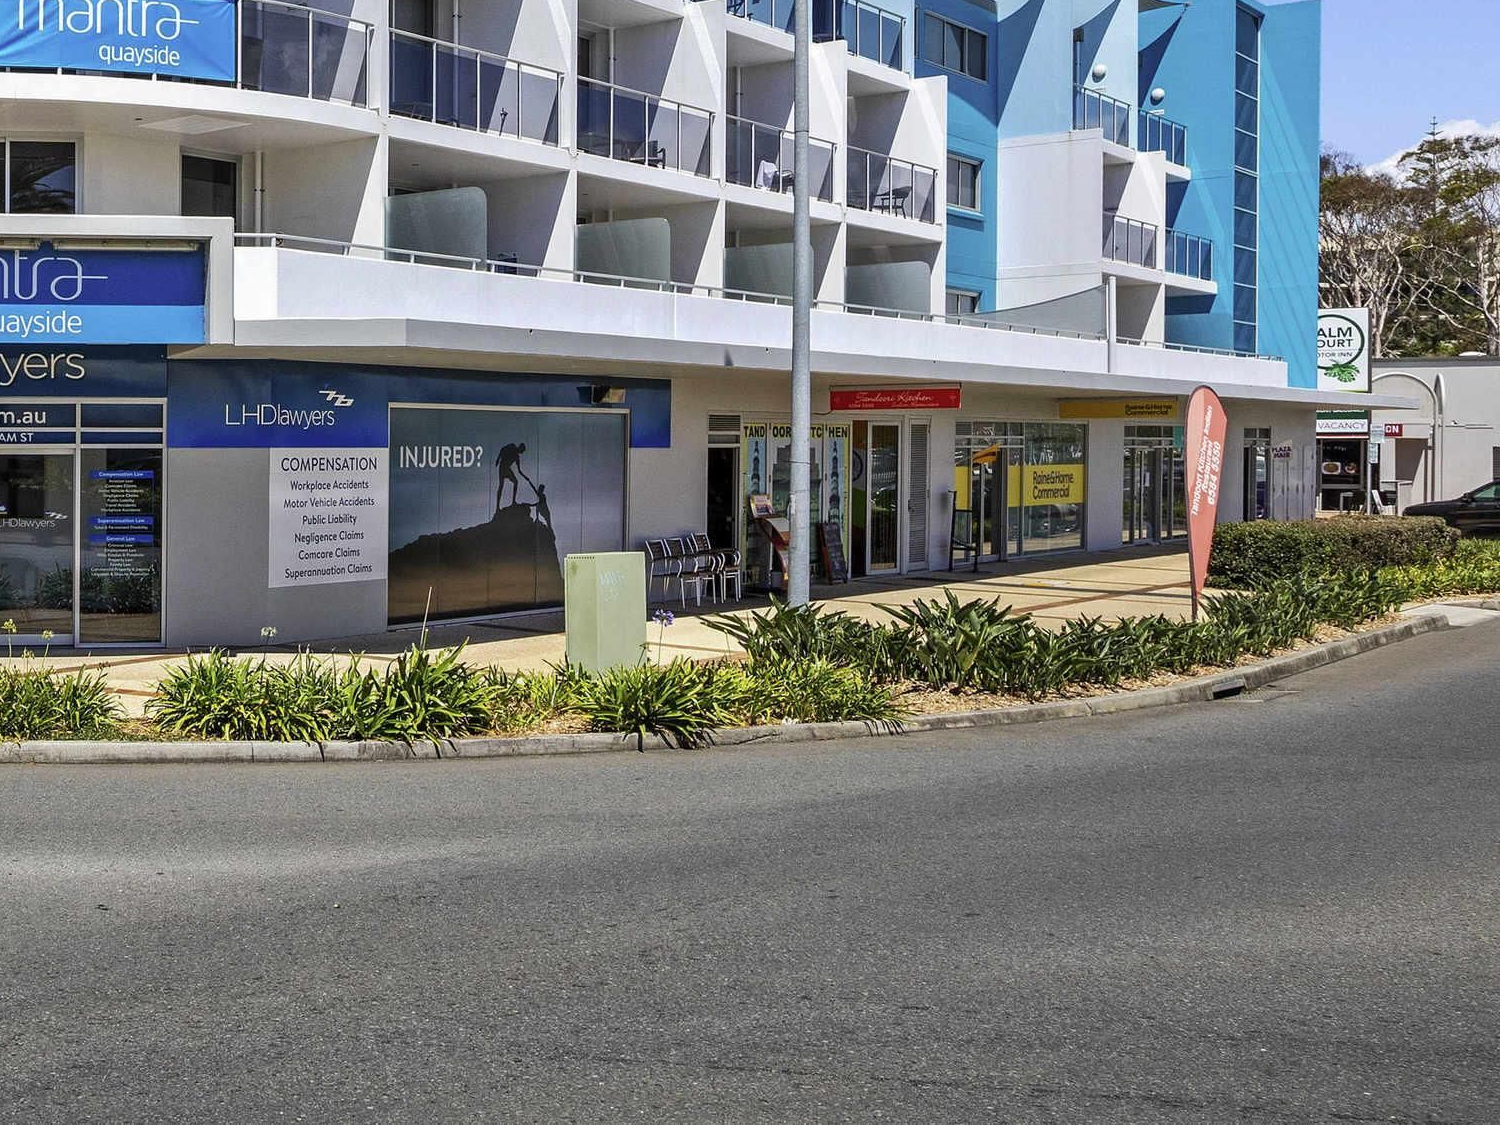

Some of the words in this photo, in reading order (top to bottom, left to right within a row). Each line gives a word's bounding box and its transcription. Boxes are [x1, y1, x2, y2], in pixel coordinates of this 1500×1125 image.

[99, 44, 180, 66] quayside
[1317, 327, 1352, 338] ALM
[1317, 339, 1353, 348] OURT
[225, 404, 335, 430] LHDlawyers
[1318, 420, 1366, 430] VACANCY
[19, 432, 33, 443] ST
[400, 445, 483, 468] INJURED?
[281, 457, 378, 472] COMPENSATION
[290, 480, 331, 491] Workplace
[332, 479, 369, 490] Accidents
[1033, 486, 1070, 500] Commercial
[283, 498, 308, 508] Motor
[309, 498, 337, 508] Vehicle
[338, 497, 375, 507] Accidents
[302, 515, 325, 525] Public
[327, 514, 357, 526] Liability
[294, 533, 337, 545] Negligence
[339, 531, 364, 542] Claims
[298, 549, 334, 560] Comcare
[335, 548, 360, 559] Claims
[284, 566, 346, 579] Superannuation
[347, 563, 373, 575] Claims
